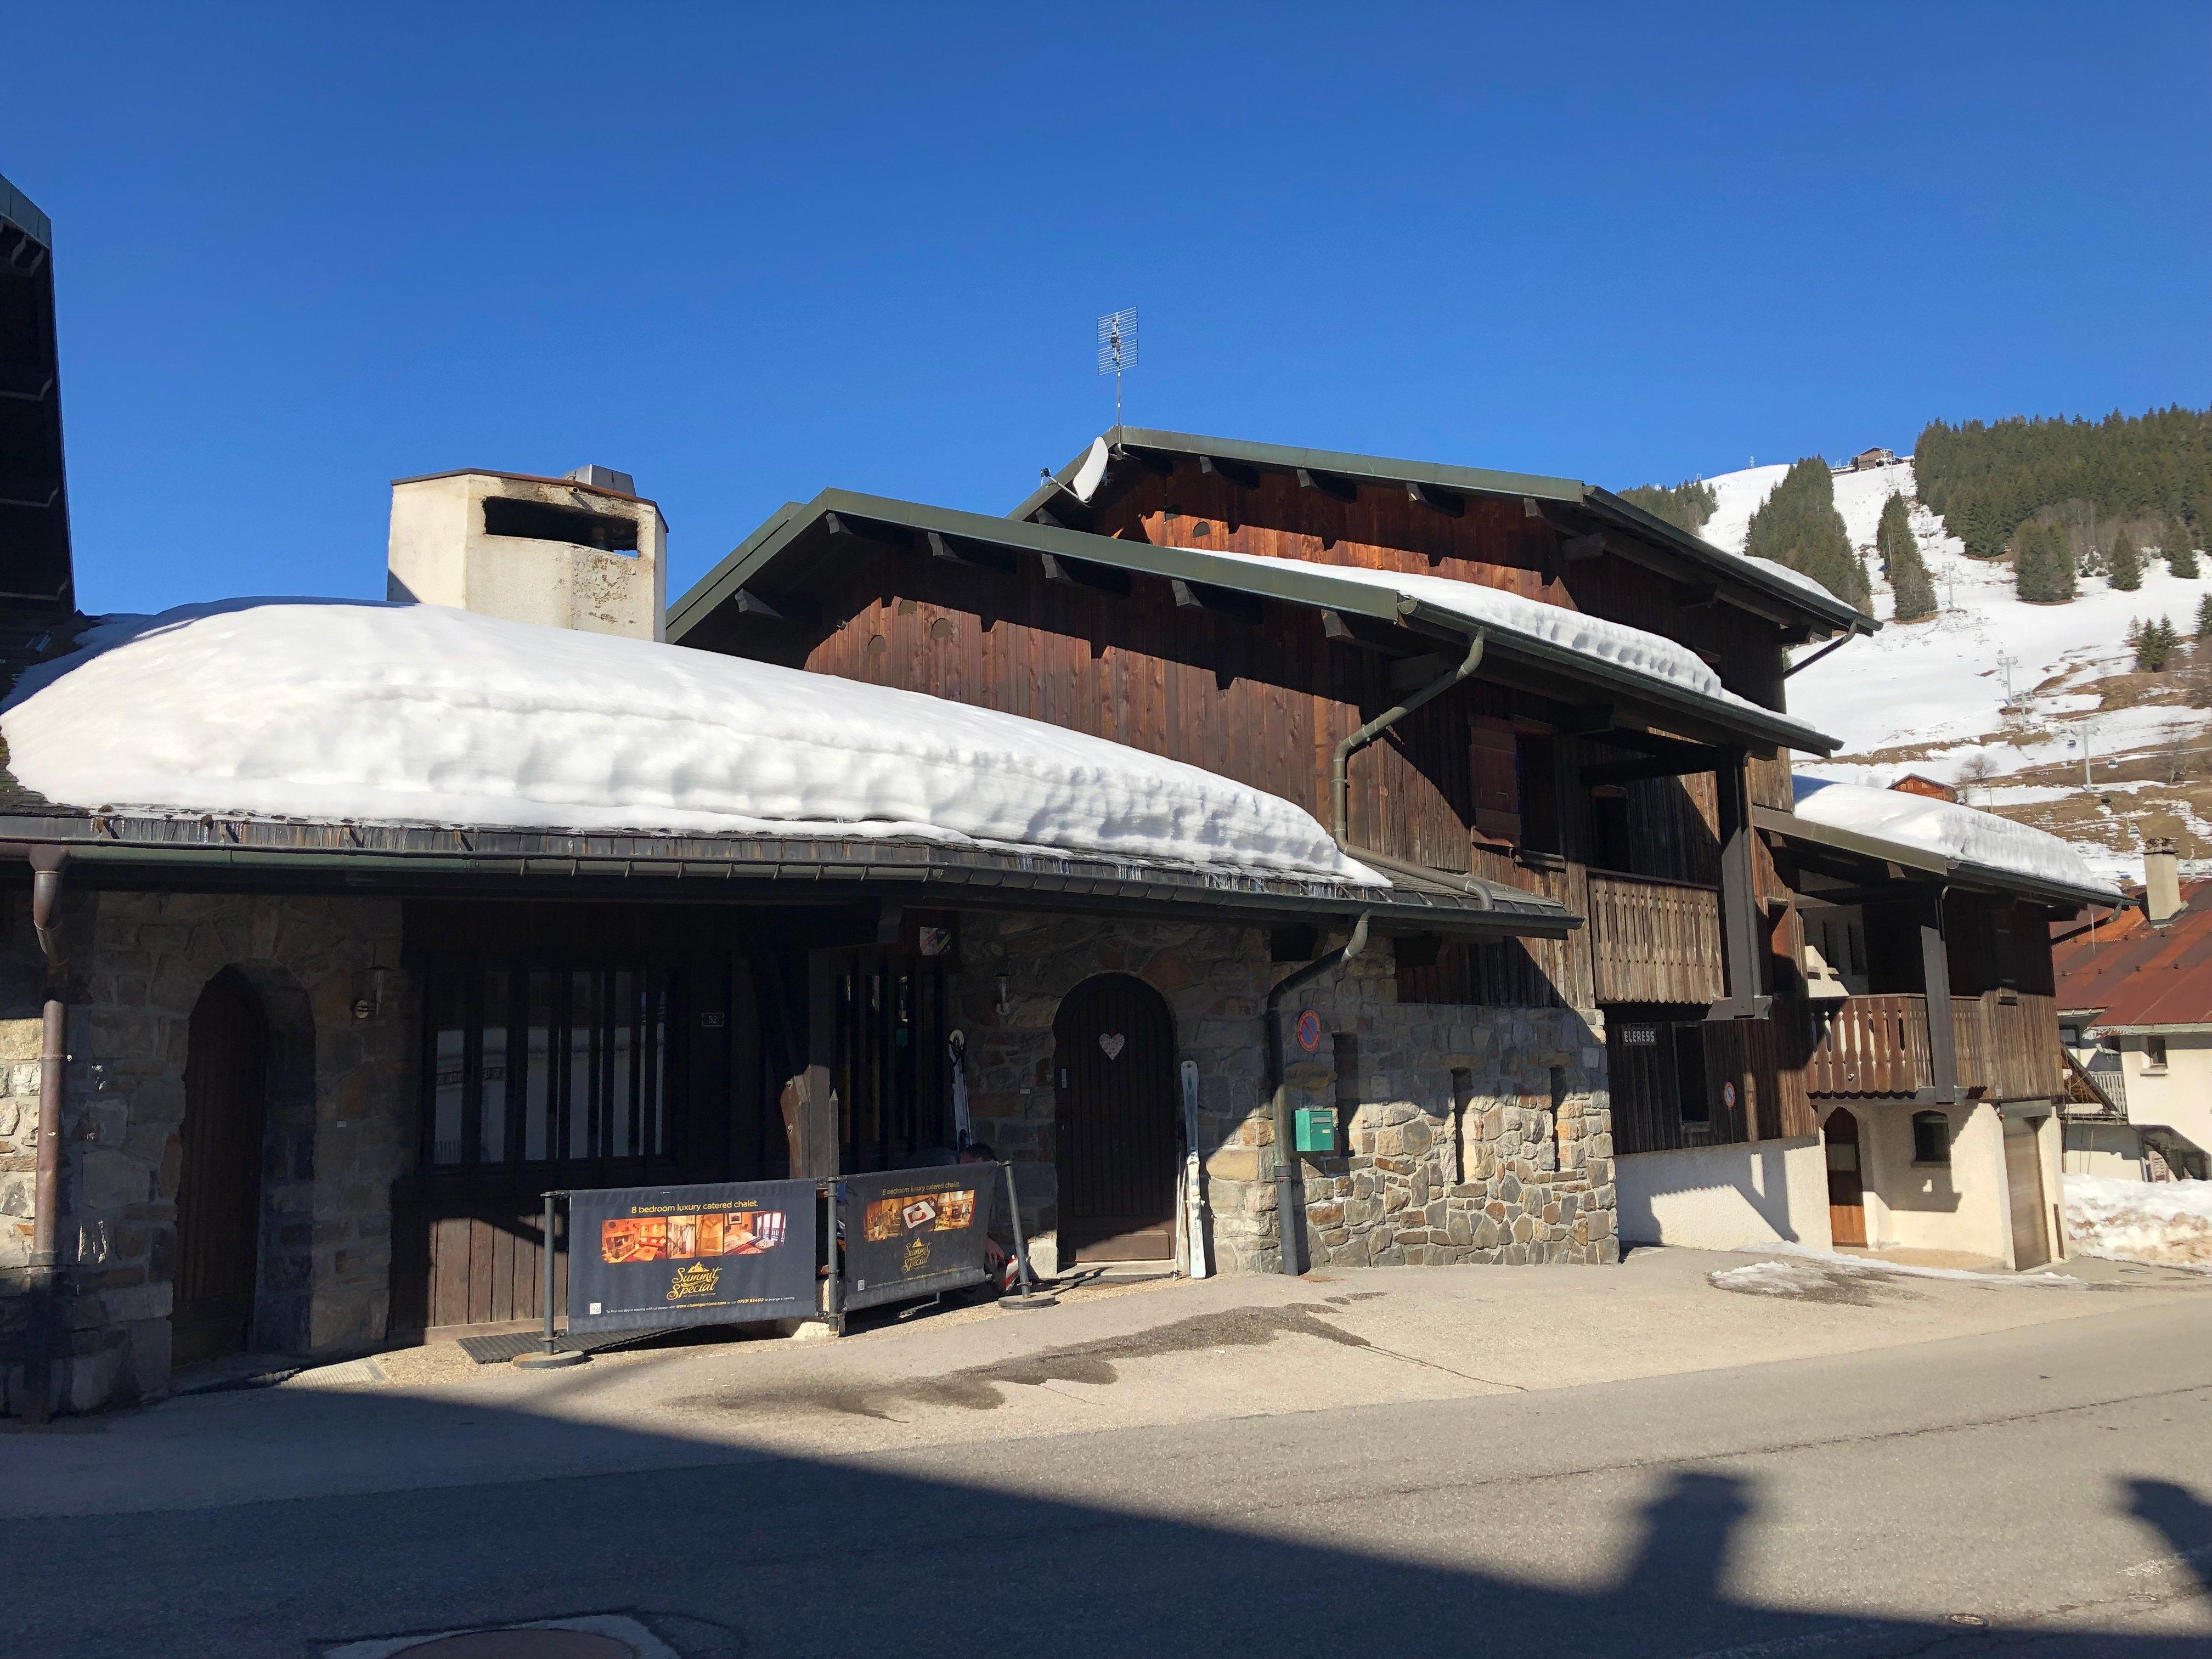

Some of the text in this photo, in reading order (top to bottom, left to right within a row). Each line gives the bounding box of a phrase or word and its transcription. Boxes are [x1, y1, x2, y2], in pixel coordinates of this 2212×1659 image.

[708, 1015, 718, 1024] 52
[639, 1205, 675, 1213] bedroom
[677, 1204, 702, 1212] luxury
[703, 1200, 732, 1210] catered
[733, 1200, 759, 1208] chalet.
[901, 1250, 930, 1274] Special
[671, 1266, 723, 1284] Summit
[666, 1277, 719, 1300] Special
